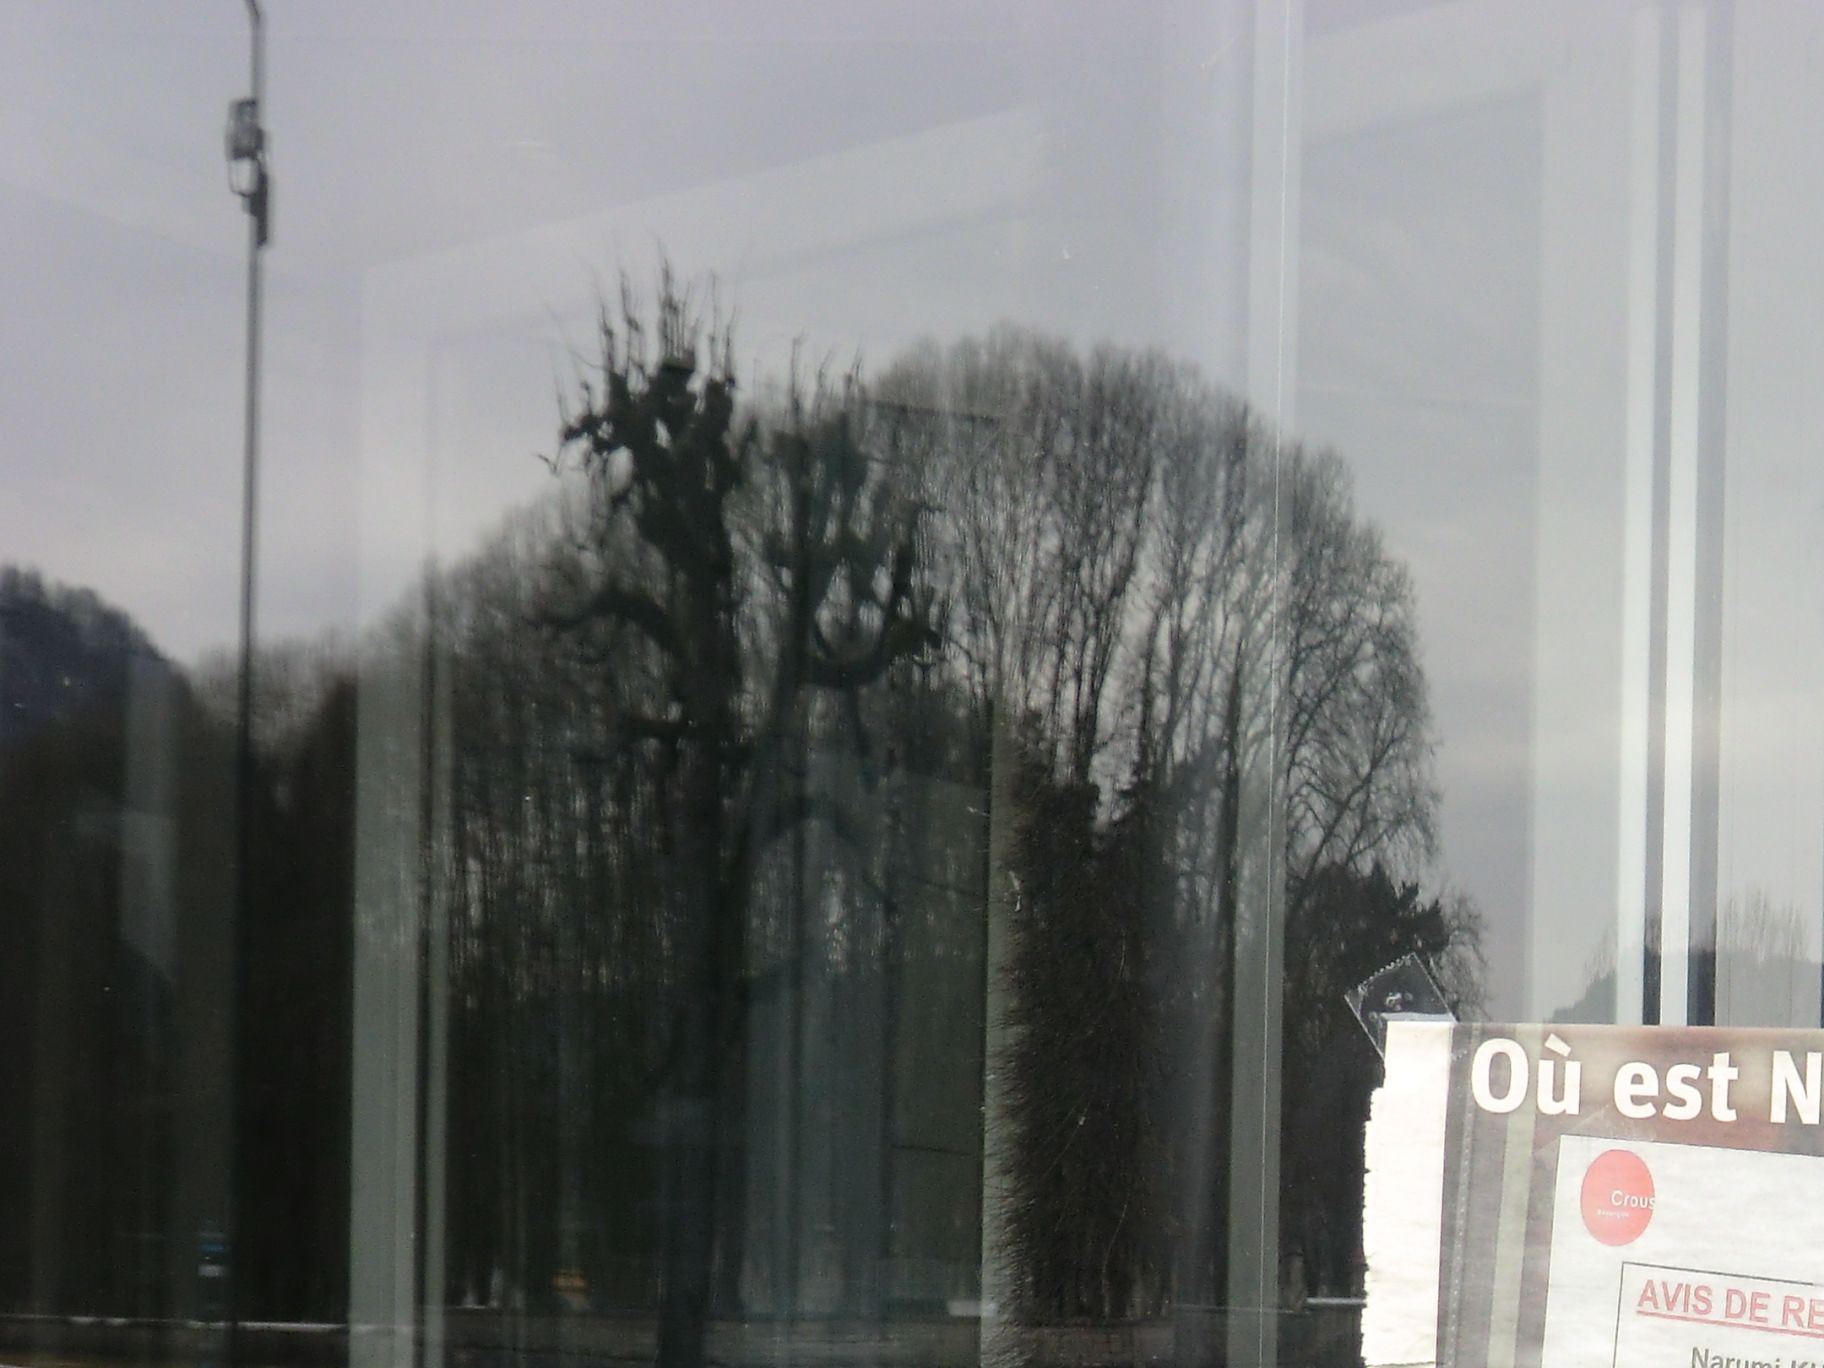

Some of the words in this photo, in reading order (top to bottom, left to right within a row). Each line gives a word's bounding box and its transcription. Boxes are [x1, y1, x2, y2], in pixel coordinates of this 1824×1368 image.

[1471, 1033, 1581, 1115] Où
[1613, 1052, 1738, 1122] est
[1611, 1190, 1655, 1210] Crous
[1637, 1279, 1713, 1315] AVIS
[1725, 1288, 1771, 1323] DE
